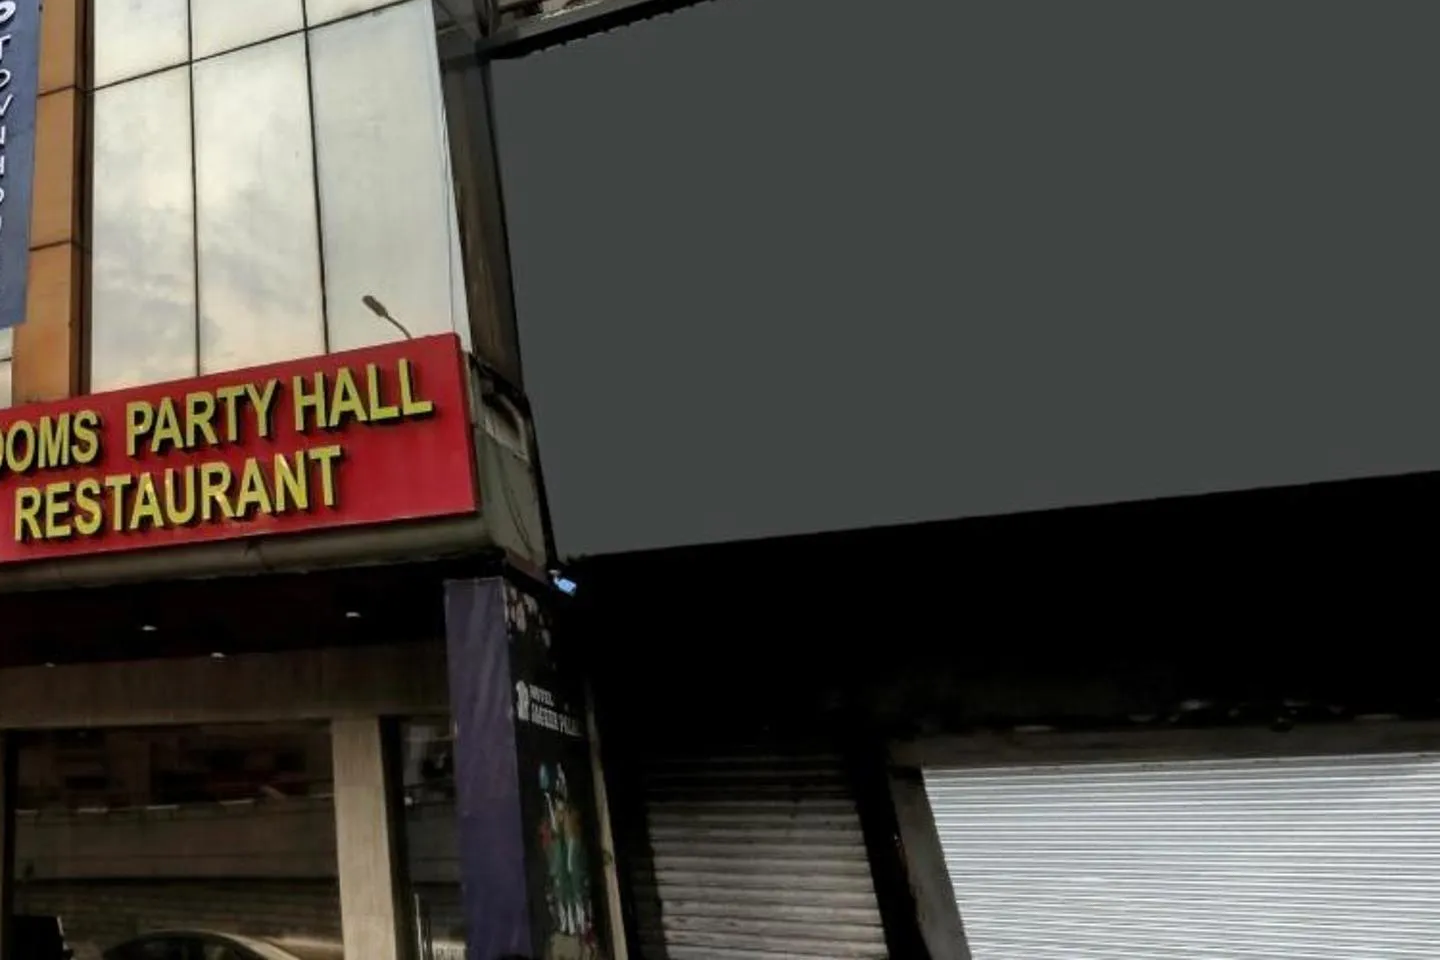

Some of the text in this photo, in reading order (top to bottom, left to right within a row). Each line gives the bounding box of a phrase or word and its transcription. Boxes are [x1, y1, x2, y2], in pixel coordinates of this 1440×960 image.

[125, 378, 281, 457] PARTY
[292, 357, 435, 432] HALL
[14, 443, 343, 543] RESTAURANT
